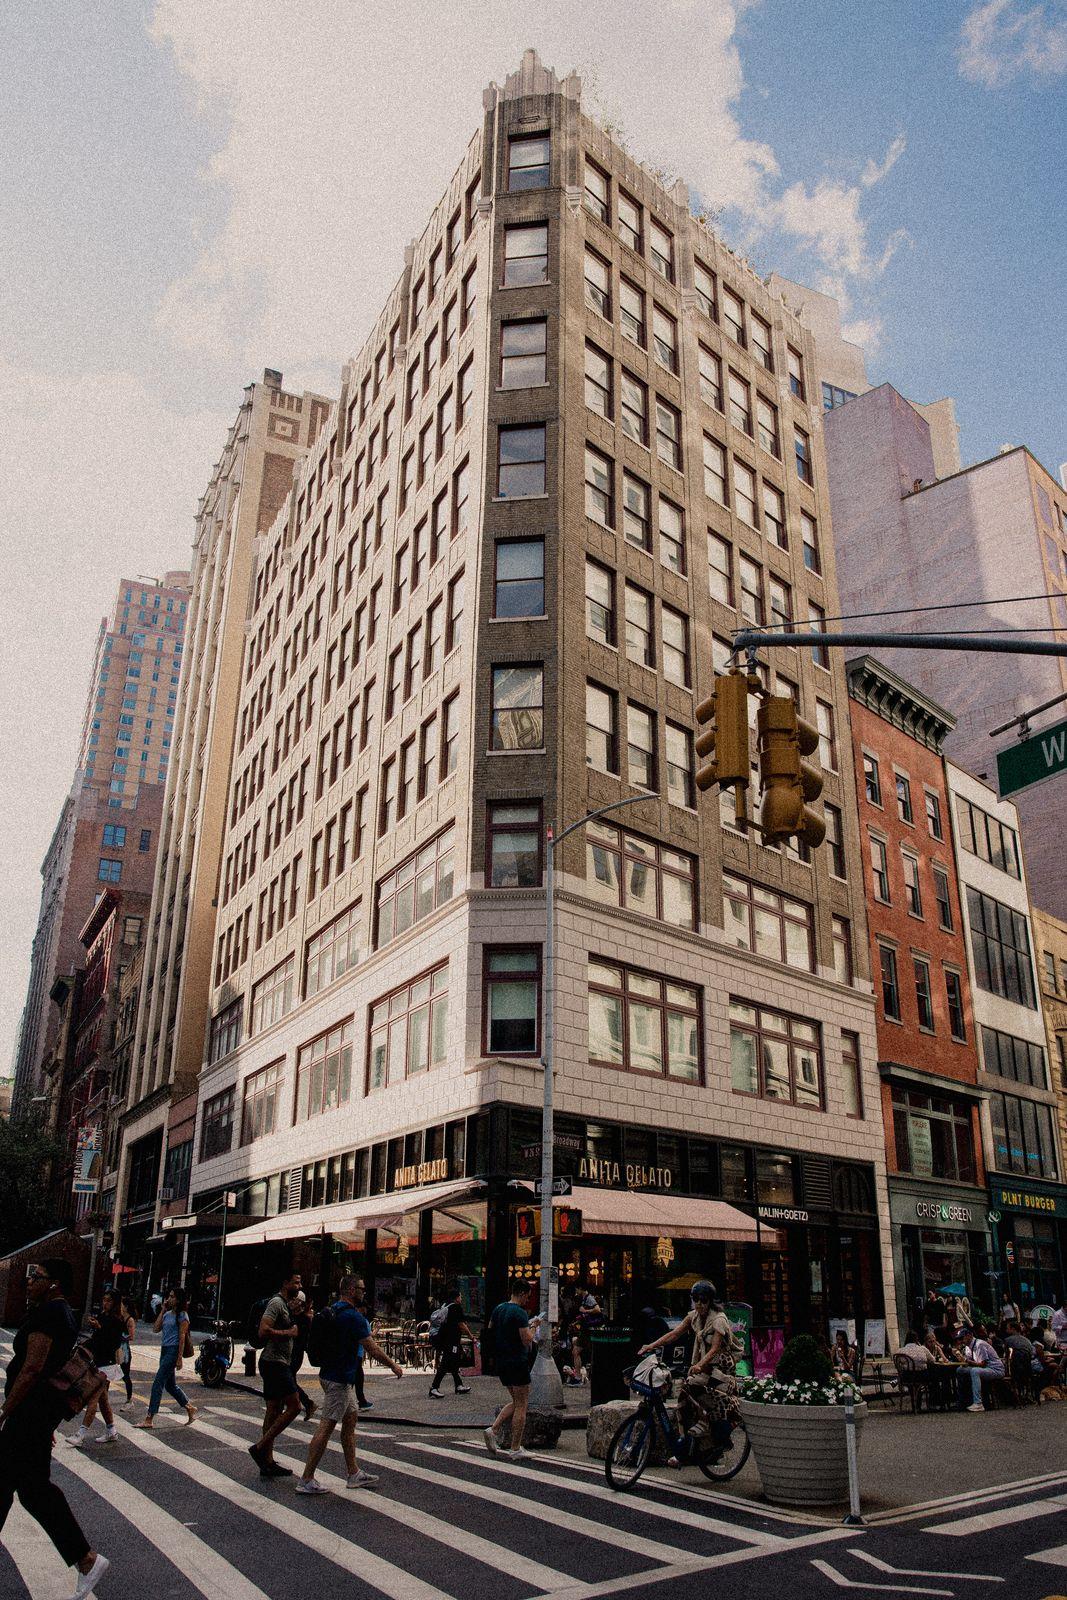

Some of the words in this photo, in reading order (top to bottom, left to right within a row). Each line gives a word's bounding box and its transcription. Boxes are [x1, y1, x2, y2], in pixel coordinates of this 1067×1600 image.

[1041, 731, 1065, 768] W
[394, 1165, 417, 1187] ANITA
[418, 1158, 448, 1183] GELATO
[579, 1158, 620, 1181] ANITA
[626, 1165, 671, 1188] GELATO
[1002, 1191, 1022, 1206] PLNT
[1024, 1194, 1056, 1211] BURGER
